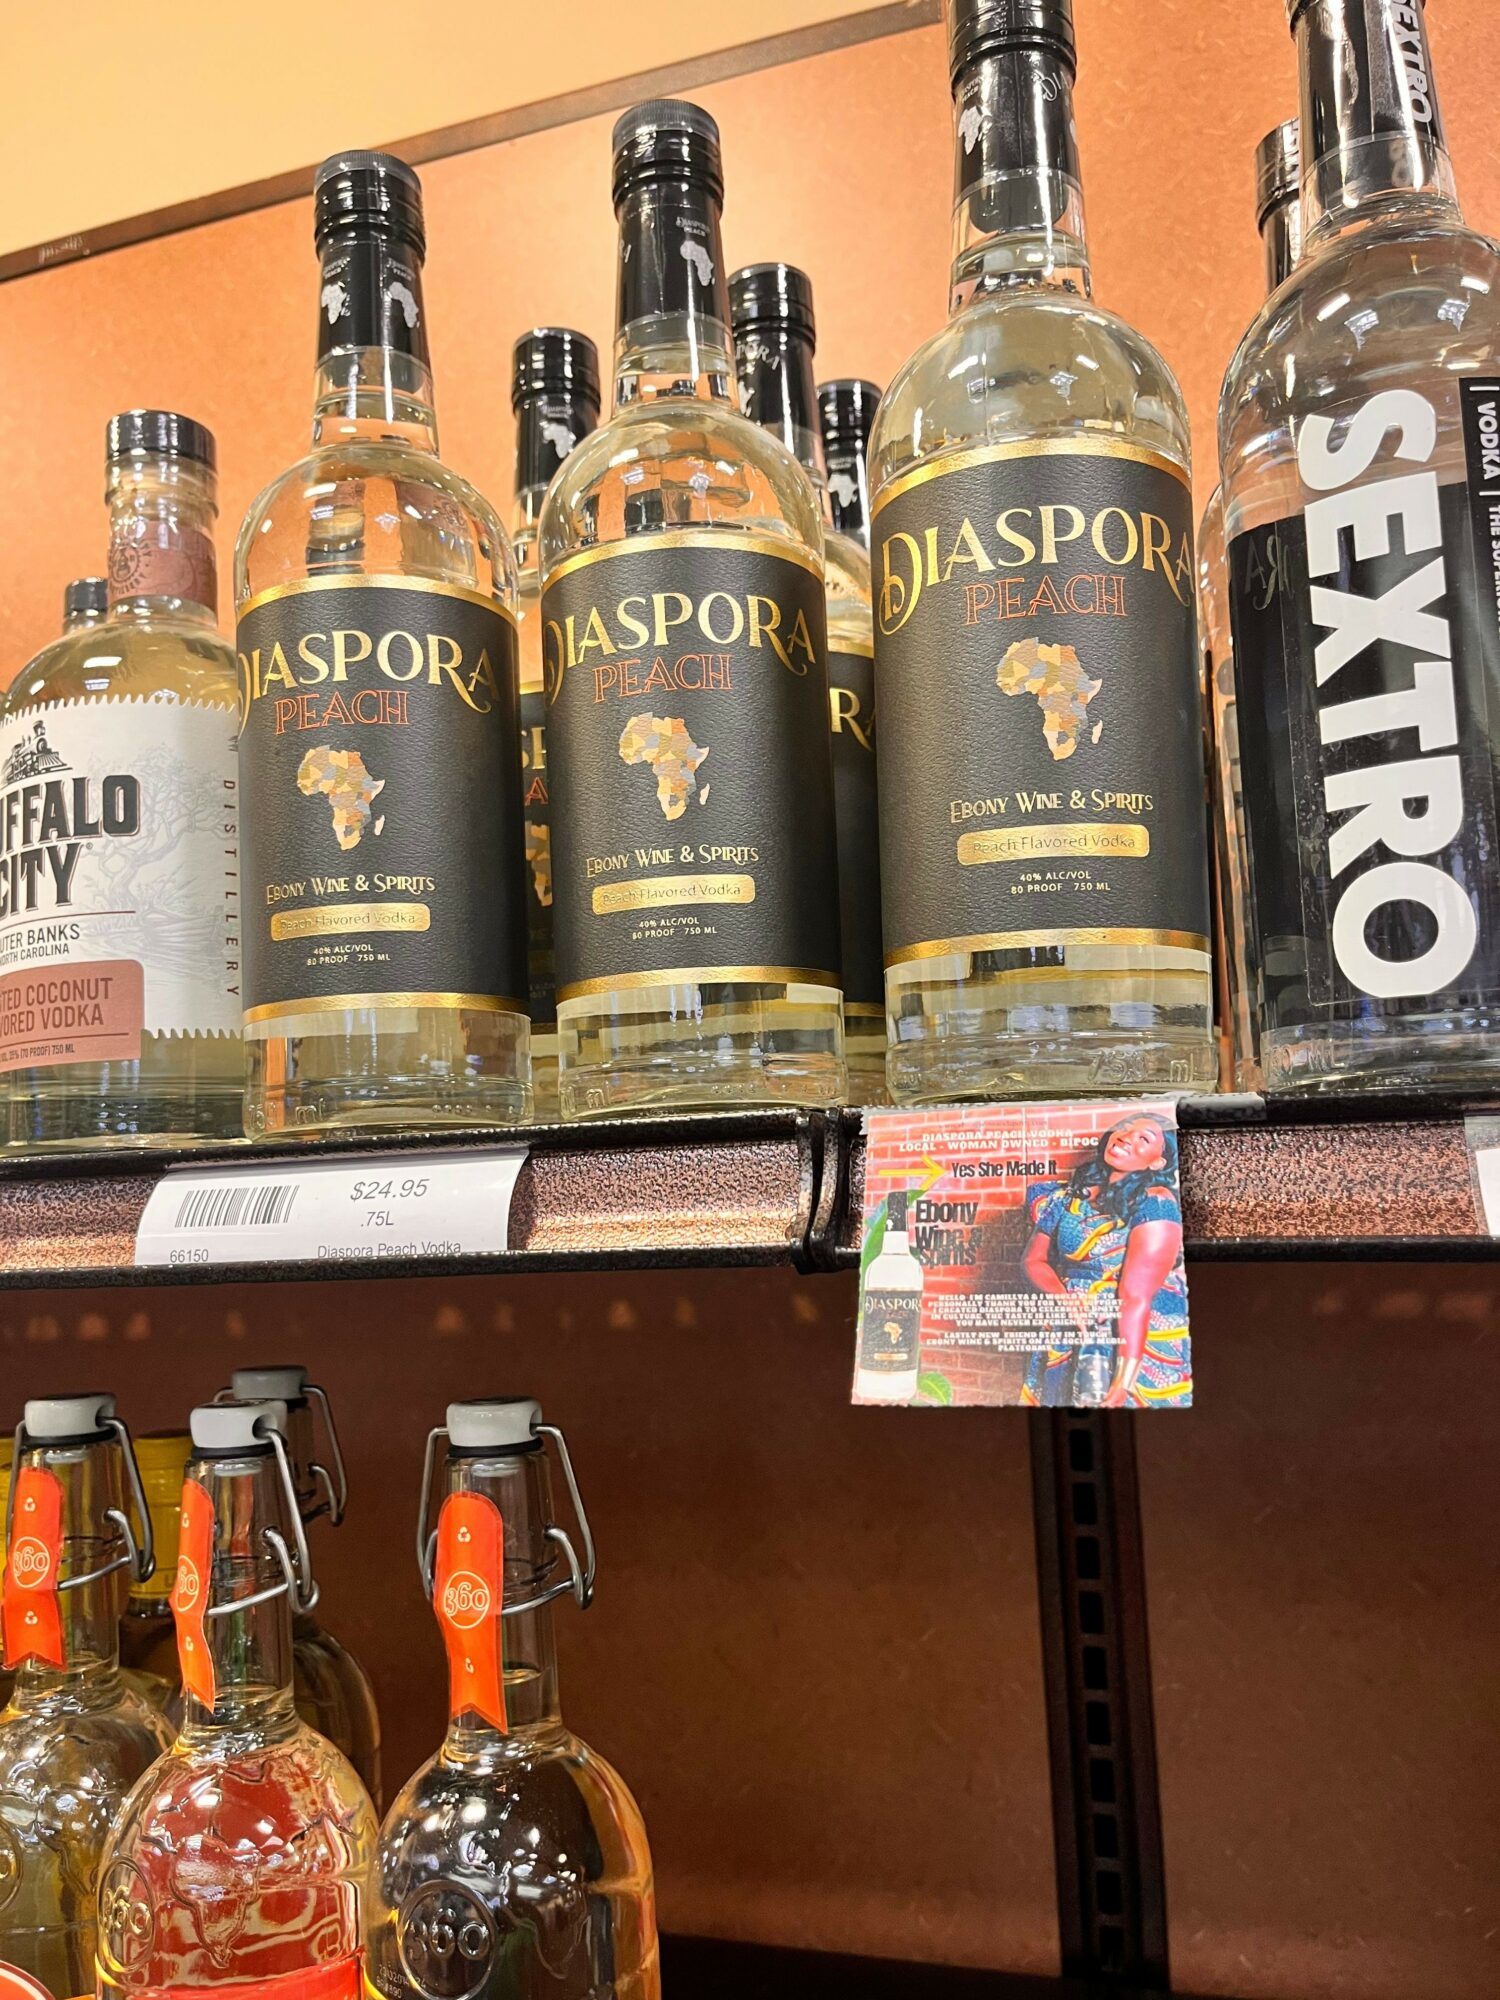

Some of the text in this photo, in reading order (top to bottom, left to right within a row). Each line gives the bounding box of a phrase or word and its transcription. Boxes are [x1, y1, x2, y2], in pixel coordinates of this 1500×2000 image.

[1391, 0, 1433, 123] EXTRO
[1477, 401, 1500, 480] VODKA
[879, 505, 1195, 635] DIASPORA
[964, 574, 1128, 625] PEACH
[592, 653, 734, 704] PEACH
[1299, 389, 1477, 998] SEXTRO
[274, 690, 410, 735] PEACH
[0, 775, 141, 855] FFALO
[950, 789, 1154, 823] EBONY WINE & SPIRITS
[1021, 834, 1088, 850] Flavored
[1091, 834, 1136, 849] Vodka
[586, 844, 760, 878] EBONY WINE & SPIRITS
[1045, 871, 1092, 880] ALC/VOL
[223, 779, 240, 996] DISTILLERY
[266, 873, 436, 905] EBONY WINE & SPIRITS
[640, 885, 697, 900] Flavored
[700, 883, 741, 896] Vodka
[1027, 883, 1063, 893] PROOF
[1073, 882, 1093, 891] 750
[1096, 882, 1112, 891] ML
[315, 912, 371, 927] Flavored
[374, 911, 416, 925] Vodka
[660, 917, 700, 927] ALC/VOL
[27, 923, 80, 946] BANKS
[645, 929, 675, 938] PROOF
[684, 927, 701, 936] 750
[704, 926, 718, 935] ML
[20, 943, 70, 961] CAROLINA
[319, 954, 349, 964] PROOF
[357, 954, 375, 962] 750
[377, 953, 391, 961] ML
[334, 943, 374, 954] ALC/VOL
[0, 977, 113, 1013] TED COCONUT
[41, 1003, 104, 1031] VODKA
[52, 1044, 64, 1055] 750
[899, 1142, 936, 1152] LOCAL
[948, 1139, 997, 1150] WOMAN
[1002, 1139, 1048, 1149] OWNED
[922, 1129, 980, 1142] DIASPORA
[1031, 1128, 1073, 1139] VODKA
[951, 1159, 1058, 1178] Yes She Made It
[350, 1179, 430, 1202] $24.95
[360, 1211, 395, 1227] .75L
[916, 1199, 979, 1226] Ebony
[317, 1240, 461, 1258] Diaspora Peach Vodka
[915, 1225, 965, 1250] Wine
[169, 1248, 209, 1264] 66150
[13, 1546, 50, 1577] 360
[444, 1581, 490, 1617] 360
